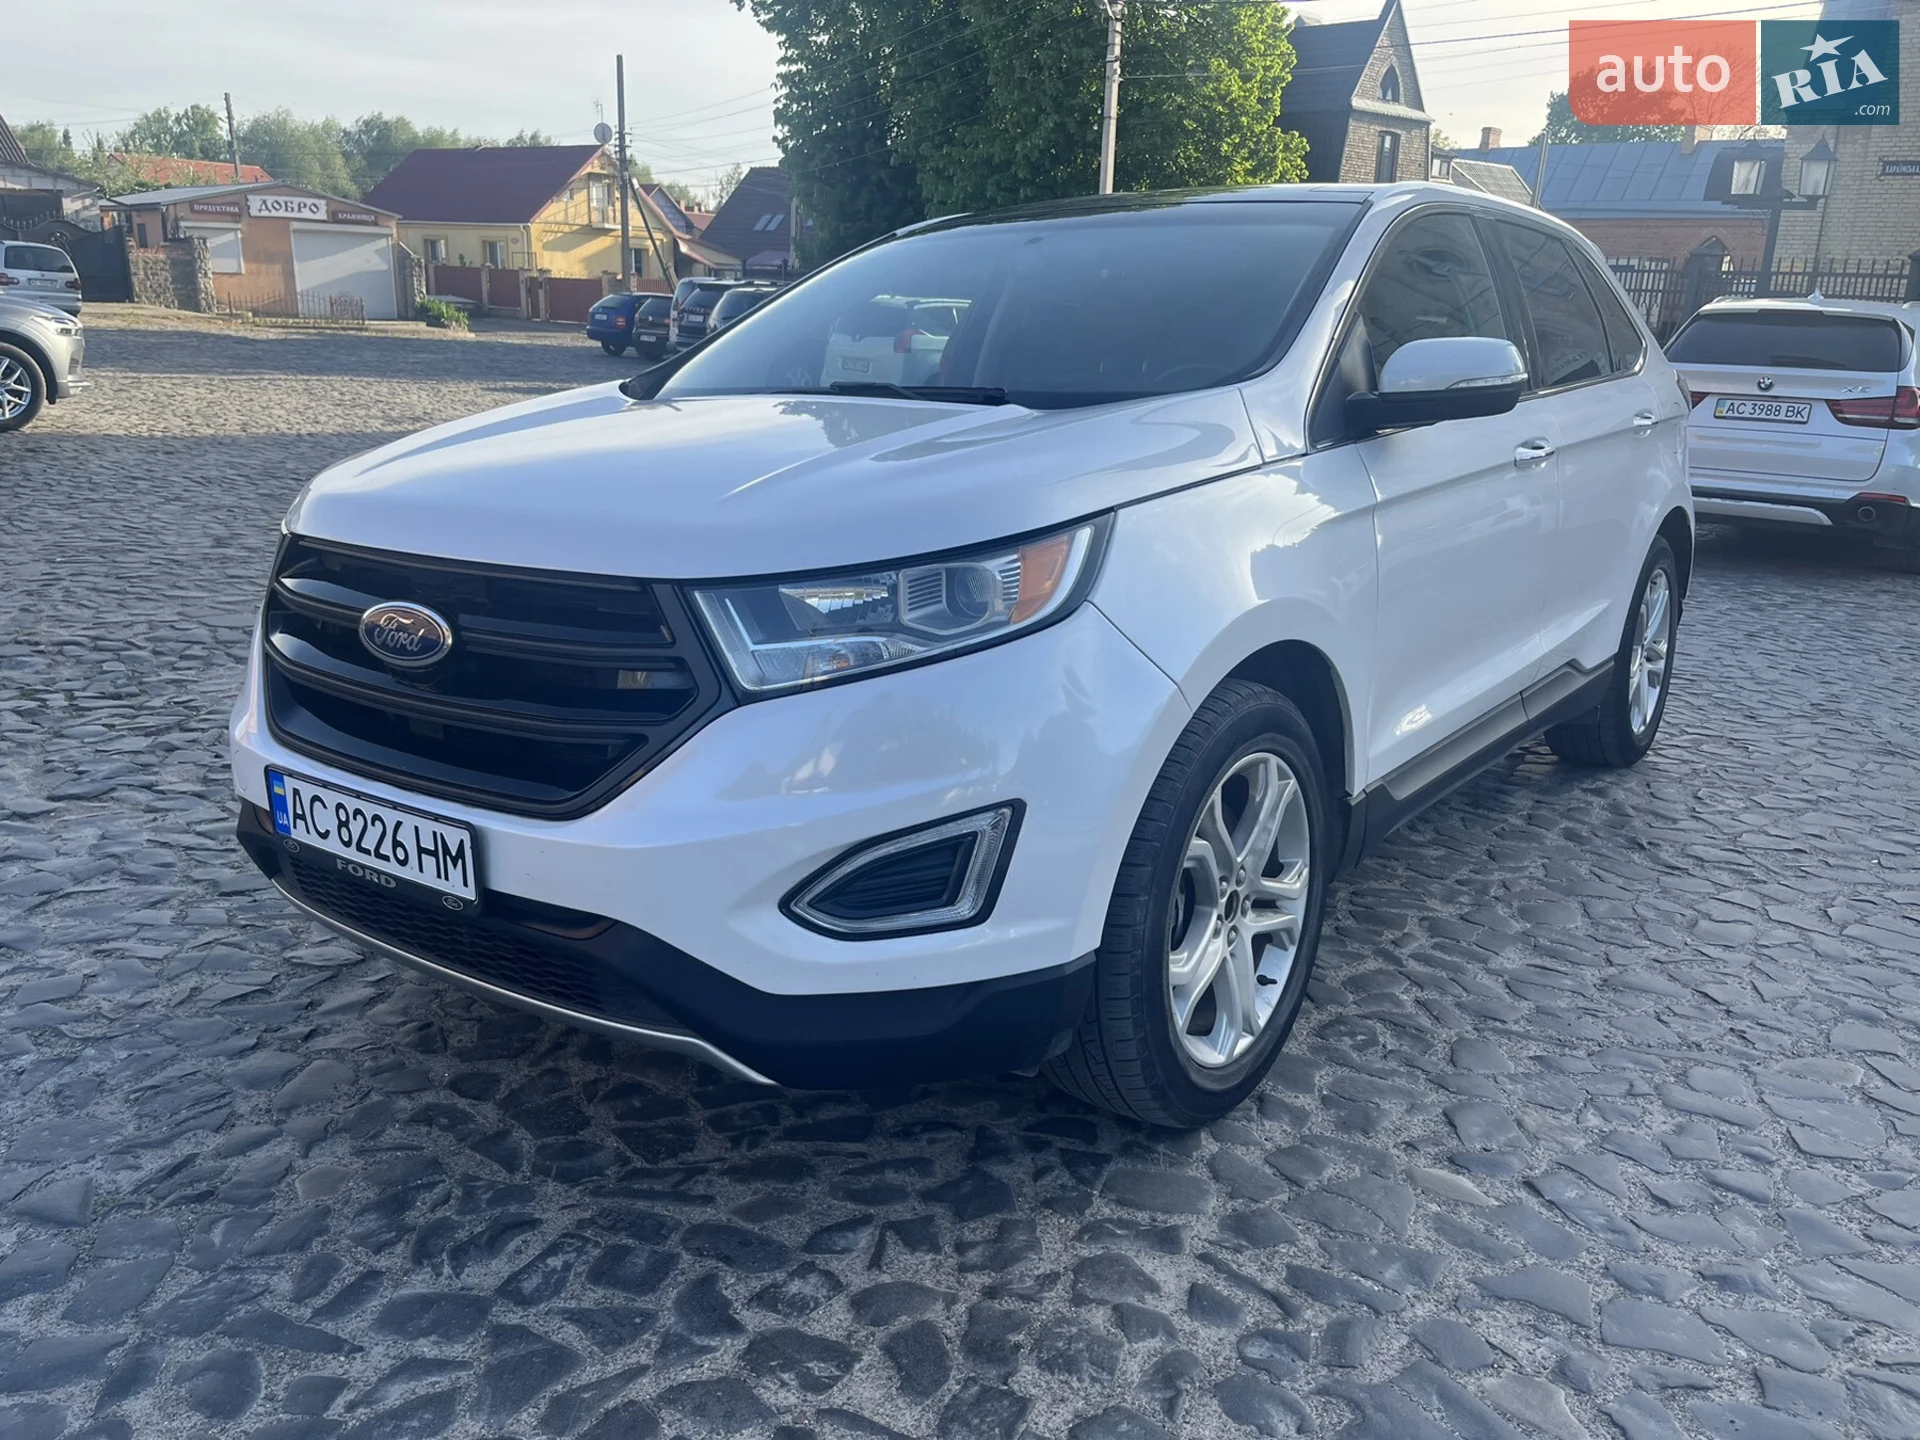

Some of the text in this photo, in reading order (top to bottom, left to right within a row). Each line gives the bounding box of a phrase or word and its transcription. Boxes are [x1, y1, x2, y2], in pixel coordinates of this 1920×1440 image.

[193, 204, 240, 213] ПРОДУКТОВА
[258, 199, 320, 215] ДОБРО
[1725, 402, 1808, 420] AC 3988 BK
[374, 612, 426, 653] Ford
[276, 810, 290, 827] UA
[292, 787, 469, 888] AC 8226 HM
[336, 858, 397, 888] FORD
